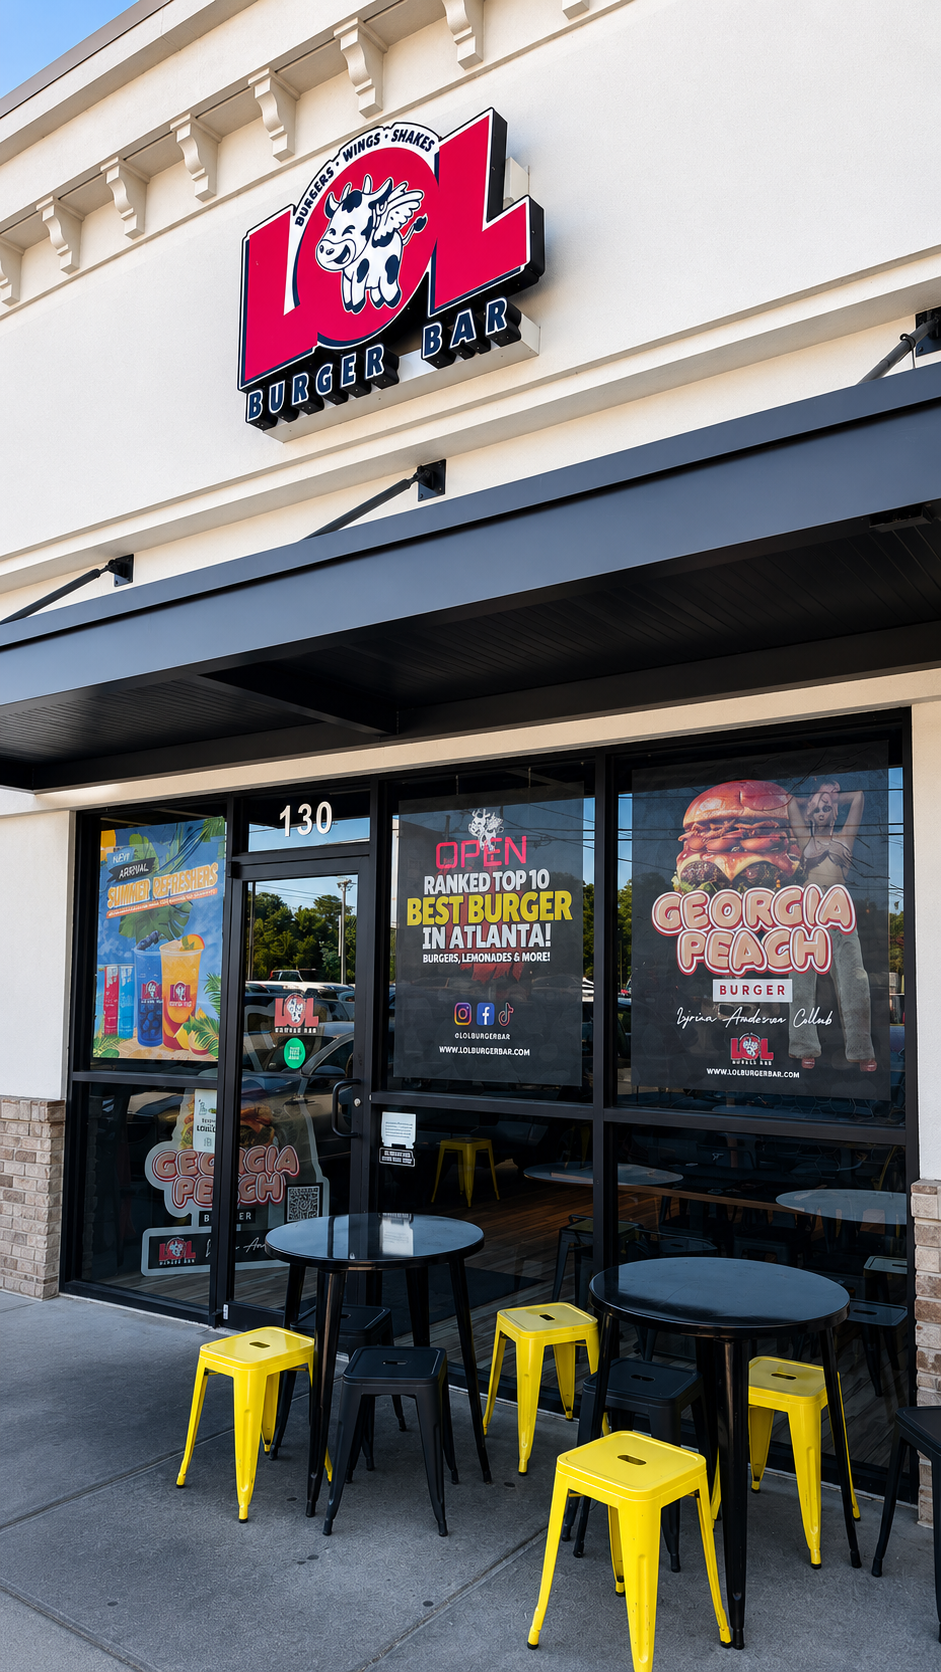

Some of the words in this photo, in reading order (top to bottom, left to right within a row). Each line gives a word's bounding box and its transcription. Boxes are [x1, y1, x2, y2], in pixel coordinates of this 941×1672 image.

[295, 166, 334, 227] BURGERS
[342, 132, 381, 162] WINGS
[391, 128, 435, 153] SHAKES
[240, 108, 531, 390] LOL
[247, 344, 385, 422] BURGER
[421, 297, 508, 360] BAR
[279, 801, 333, 837] 130
[435, 835, 527, 869] OPEN
[107, 878, 151, 909] SUMMER
[153, 862, 219, 899] REFRESHERS
[118, 863, 149, 879] ARRIVAL
[424, 872, 491, 895] RANKED
[493, 870, 527, 892] TOP
[529, 868, 550, 890] 10
[407, 895, 463, 926] BEST
[468, 890, 573, 924] BURGER
[652, 884, 857, 936] GEORGIA
[422, 926, 446, 949] IN
[449, 923, 552, 949] ATLANTA!
[677, 925, 833, 976] PEACH
[423, 953, 461, 964] BURGERS,
[461, 952, 513, 963] LEMONADES
[513, 952, 520, 962] &
[521, 951, 551, 962] MORE!
[719, 985, 786, 996] BURGER
[274, 995, 319, 1027] LOL
[793, 1006, 834, 1028] Collab
[439, 1046, 531, 1056] WWW.LOLBURGERBAR.COM
[730, 1036, 774, 1060] LOL
[706, 1068, 800, 1078] WWW.LOLBURGERBAR.COM
[172, 1172, 286, 1209] PECH
